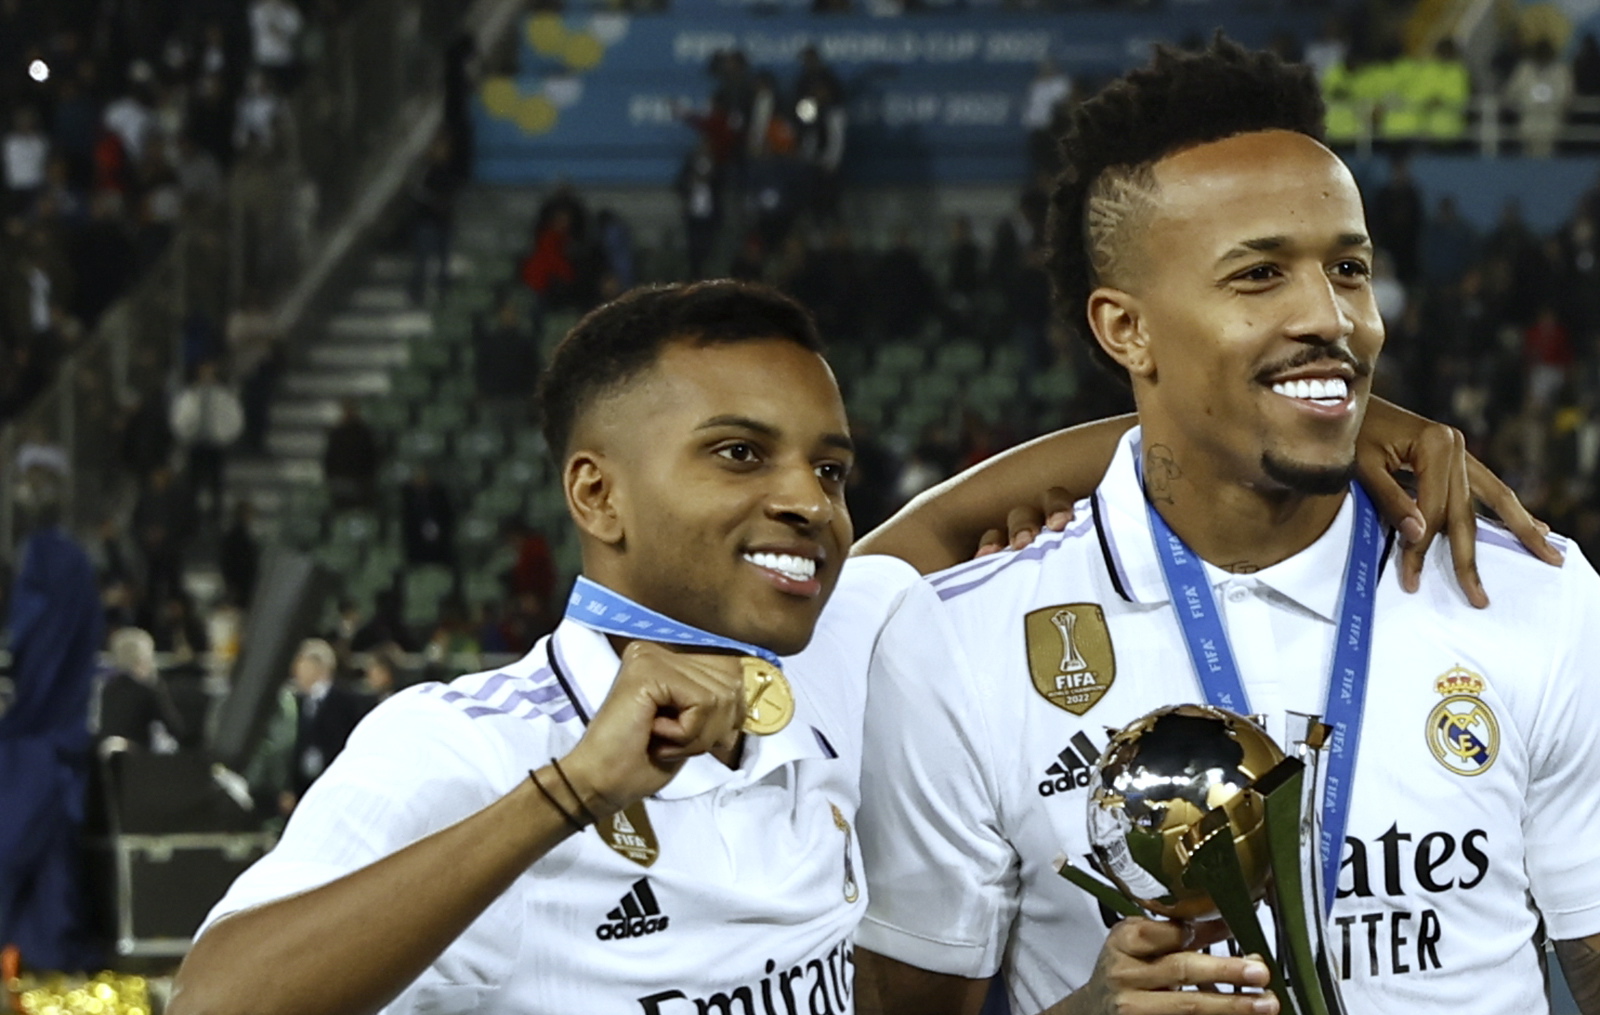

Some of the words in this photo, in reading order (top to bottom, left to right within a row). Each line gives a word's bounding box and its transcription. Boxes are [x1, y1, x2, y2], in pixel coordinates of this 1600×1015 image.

[1355, 561, 1368, 598] FIFA
[1182, 585, 1204, 619] FIFA
[1348, 614, 1362, 651] FIFA
[1201, 639, 1222, 673] FIFA
[1055, 672, 1096, 690] FIFA
[1340, 667, 1355, 704] FIFA
[1066, 694, 1090, 705] 2022
[1332, 721, 1347, 759] FIFA
[1038, 766, 1091, 798] adid
[1325, 775, 1339, 814] FIFA
[612, 832, 648, 849] FIFA
[1335, 820, 1489, 899] ates
[595, 914, 670, 942] adidas
[1335, 909, 1443, 981] TTER
